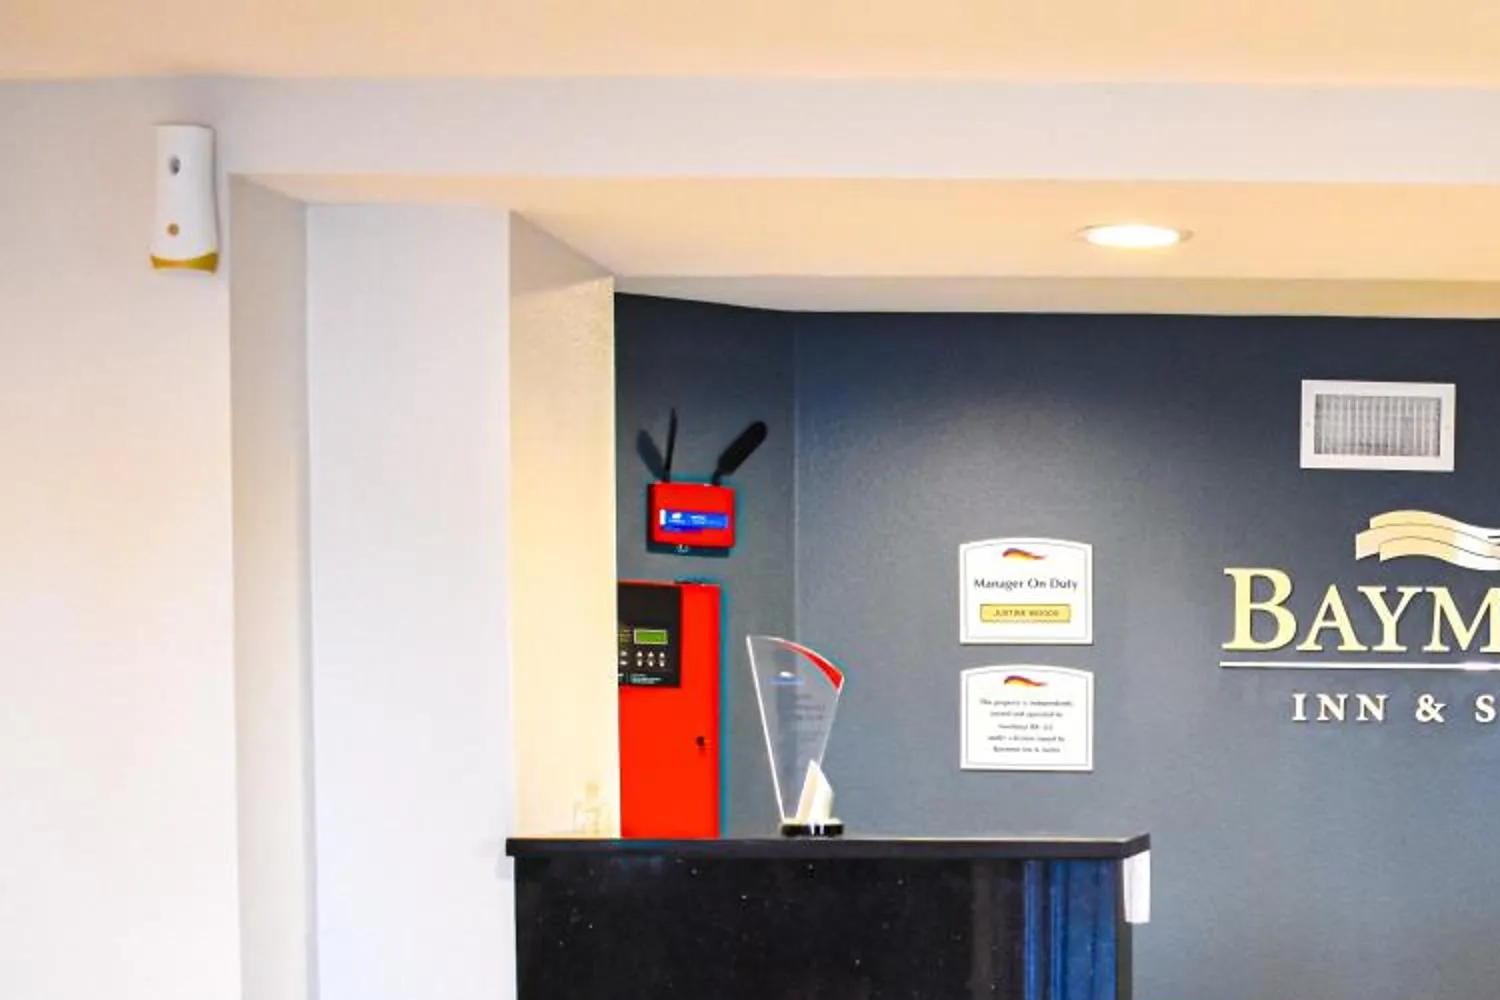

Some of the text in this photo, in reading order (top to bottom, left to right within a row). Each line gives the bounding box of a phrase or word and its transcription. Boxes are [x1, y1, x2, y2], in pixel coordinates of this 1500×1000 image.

[974, 577, 1078, 592] Manager On Duty
[1291, 692, 1388, 723] INN
[1414, 694, 1447, 723] &
